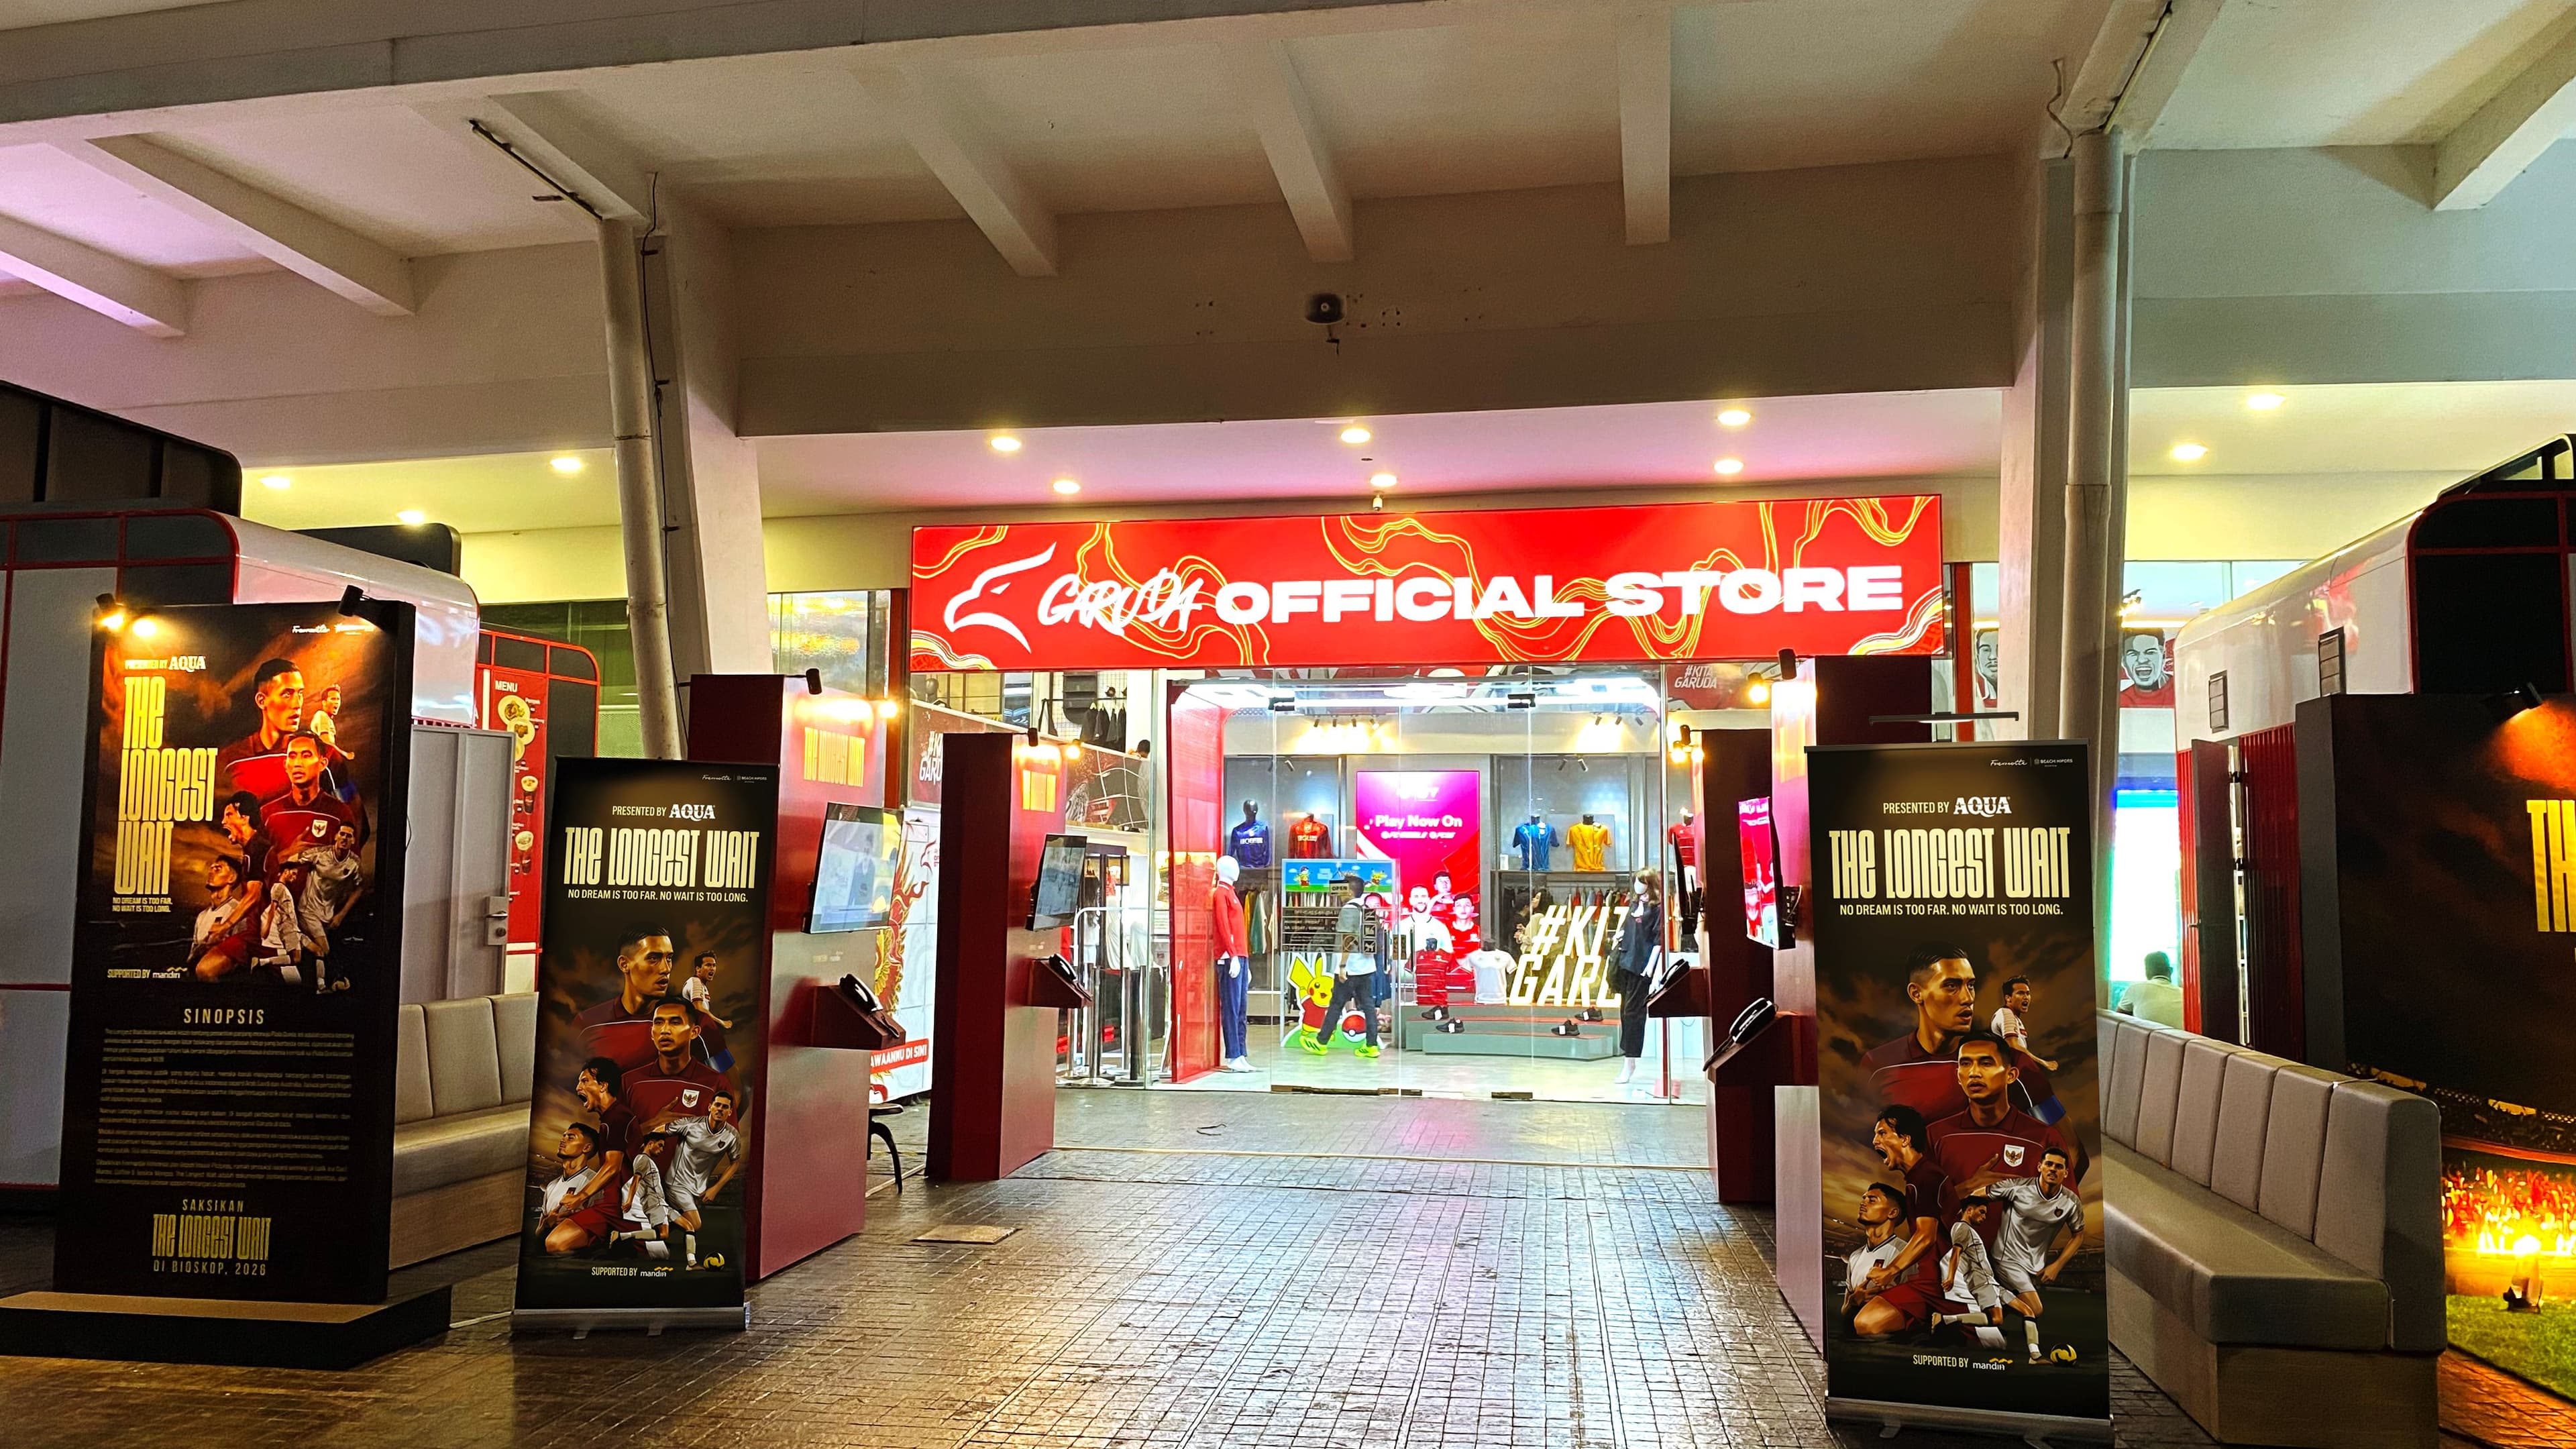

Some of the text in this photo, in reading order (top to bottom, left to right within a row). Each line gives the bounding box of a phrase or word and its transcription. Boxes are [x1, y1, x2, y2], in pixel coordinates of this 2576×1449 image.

[1038, 565, 1902, 636] GARUDA OFFICIAL STORE
[168, 655, 207, 673] AQUA
[1684, 665, 1713, 679] #KITA
[495, 680, 518, 693] MENU
[1674, 676, 1717, 690] GARUDA
[118, 748, 218, 822] LONGEST
[612, 804, 716, 822] PRESENTED BY AQUA
[1883, 796, 2012, 818] PRESENTED BY AQUA
[1375, 814, 1463, 829] Play Now On
[114, 820, 174, 895] WAIT
[564, 827, 759, 889] THE LONGEST WAIT
[1829, 826, 2070, 899] THE LONGEST WAIT
[2526, 800, 2576, 932] TH
[568, 889, 748, 902] NO DREAM IS TOO FAR. NO WAIT IS TOO LONG.
[1840, 904, 2063, 916] NO DREAM IS TOO FAR. NO WAIT IS TOO LONG.
[107, 969, 142, 979] SUPPORTED
[142, 969, 151, 979] BY
[184, 1008, 264, 1024] SINOPSIS
[905, 1046, 913, 1060] DI
[182, 1199, 244, 1212] SAKSIKAN
[152, 1214, 271, 1260] THE LONGEST WAIT
[154, 1259, 165, 1272] DI
[591, 1267, 628, 1276] SUPPORTED
[629, 1267, 638, 1277] BY
[1913, 1354, 1957, 1367] SUPPORTED
[1958, 1357, 1969, 1368] BY
